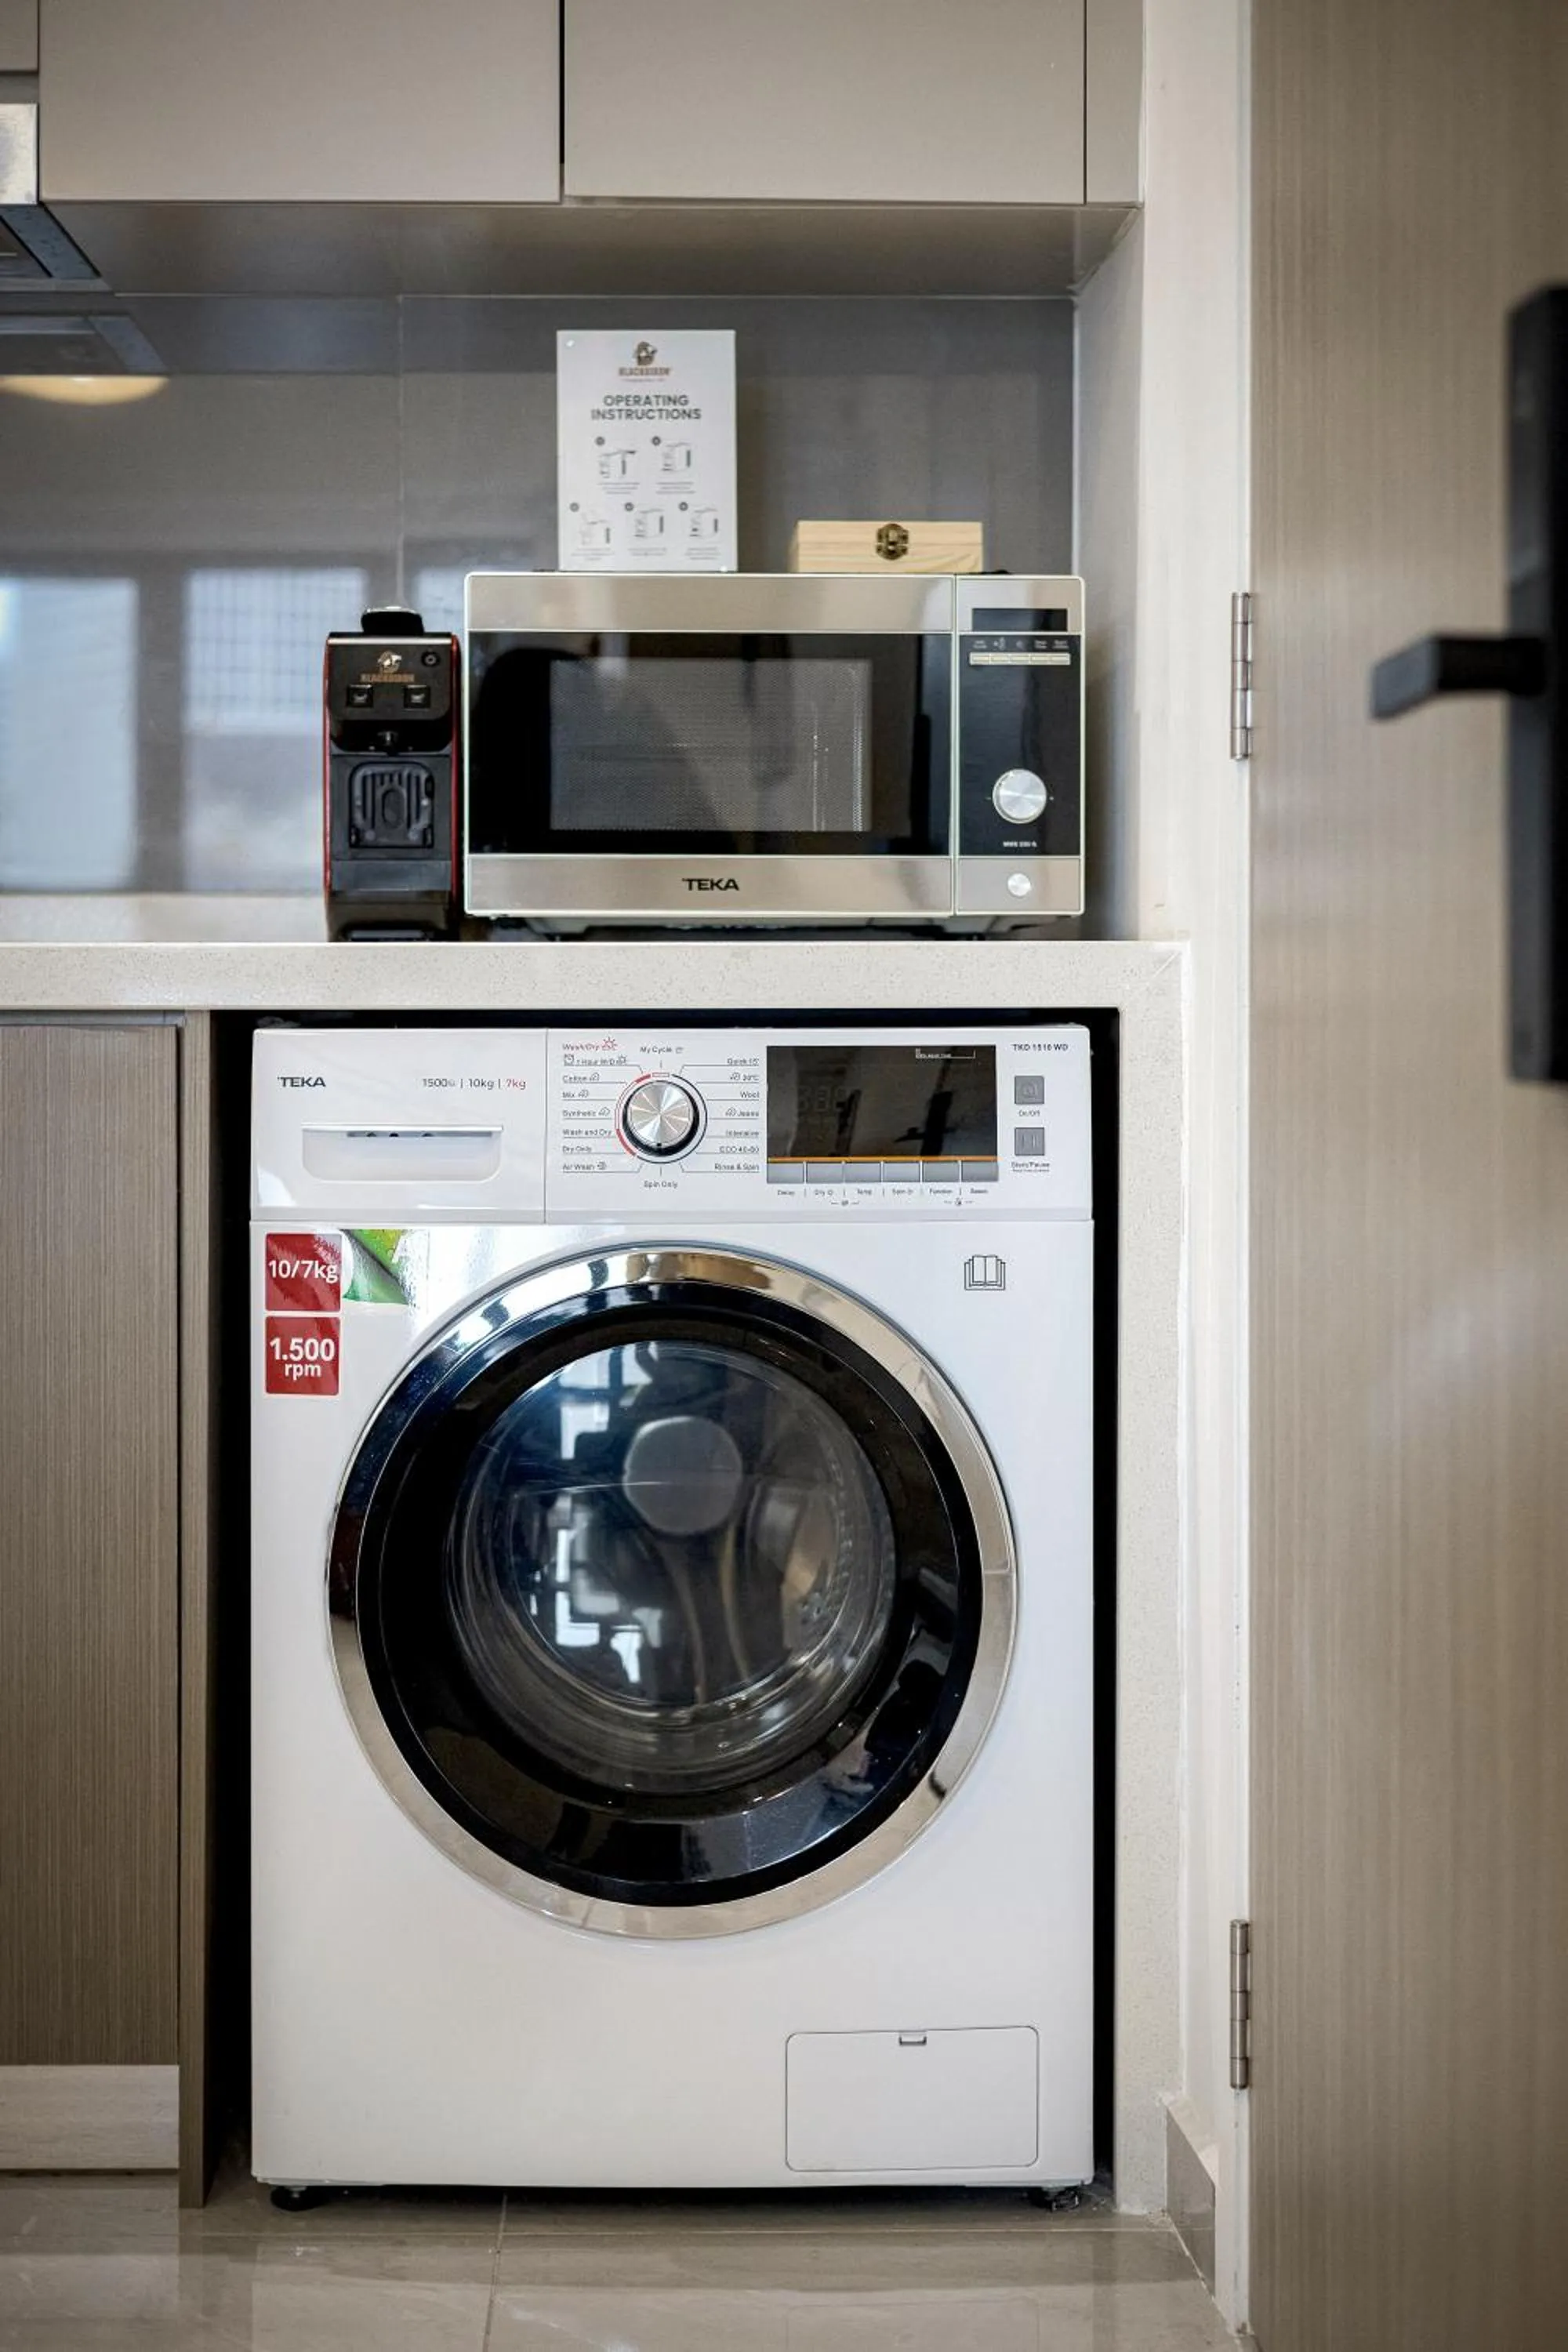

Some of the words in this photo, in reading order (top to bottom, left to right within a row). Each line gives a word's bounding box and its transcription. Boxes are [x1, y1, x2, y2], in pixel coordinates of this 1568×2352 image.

[603, 394, 689, 407] OPERATING
[590, 408, 702, 420] INSTRUCTIONS
[681, 877, 739, 891] TEKA
[277, 1076, 326, 1087] TEKA
[423, 1078, 448, 1087] 1500
[468, 1078, 494, 1091] 10kg
[506, 1078, 526, 1091] 7kg
[644, 1180, 660, 1189] Spin
[268, 1259, 339, 1284] 10/7kg
[269, 1338, 335, 1362] 1.500
[284, 1363, 321, 1381] rpm
